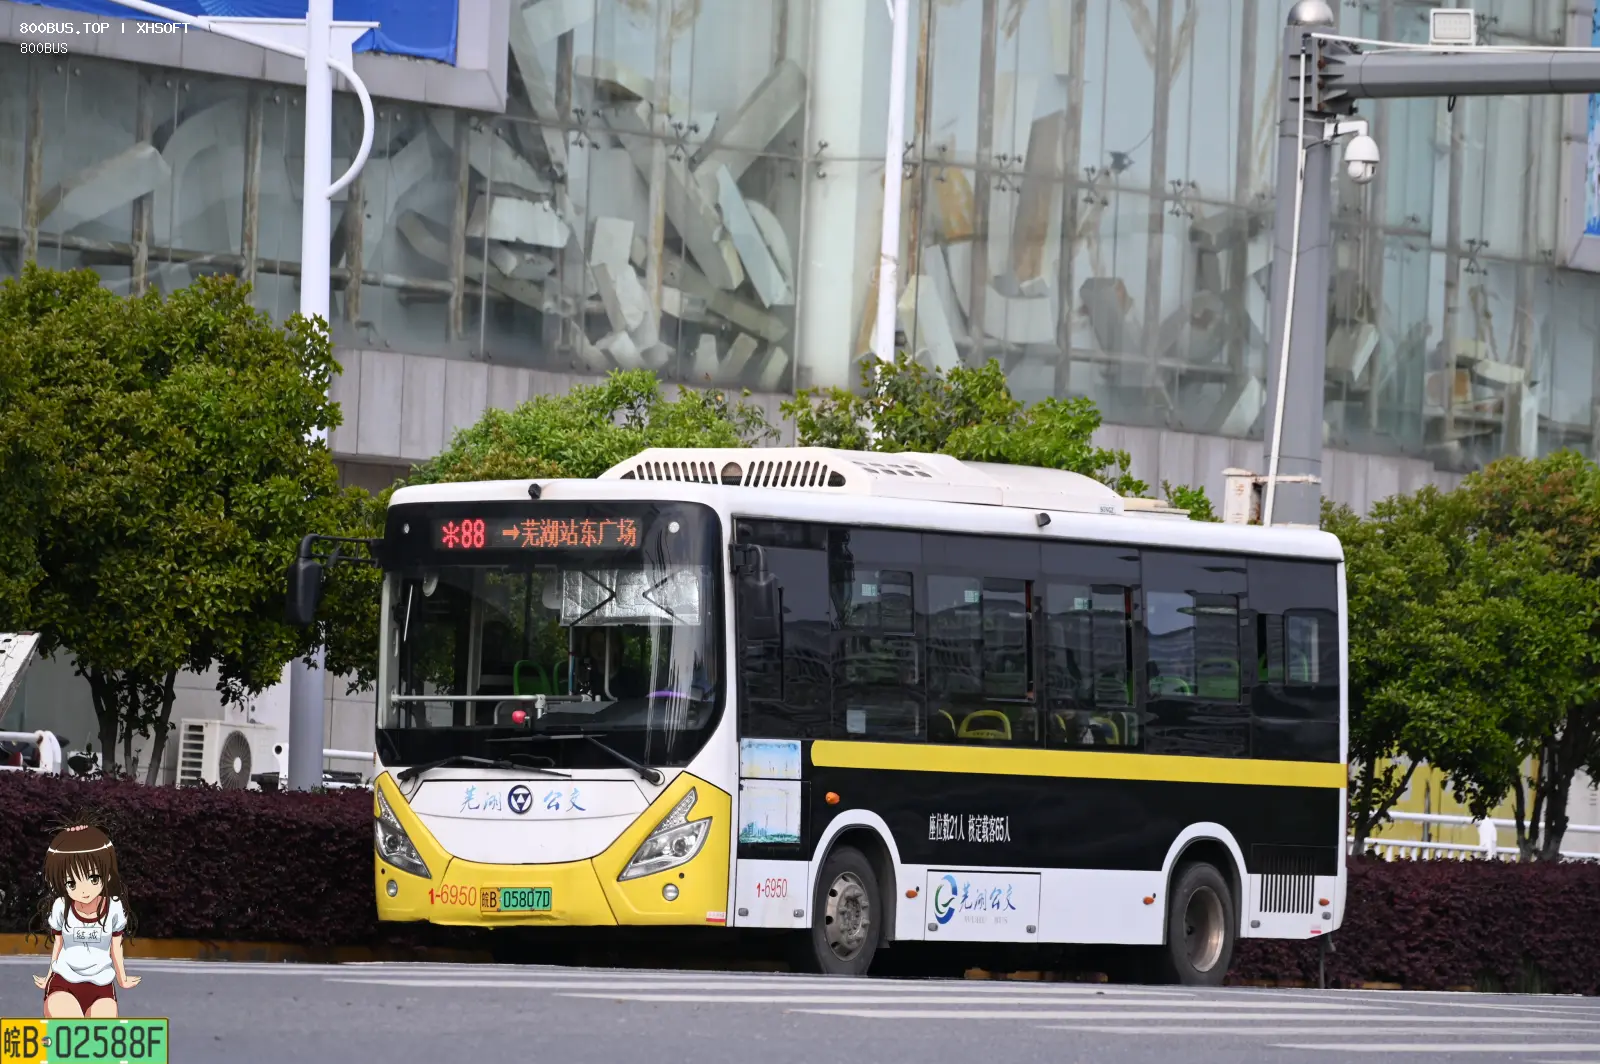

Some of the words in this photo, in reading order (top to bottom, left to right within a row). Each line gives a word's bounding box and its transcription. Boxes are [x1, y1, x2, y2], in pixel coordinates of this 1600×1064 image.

[520, 518, 637, 548] 芜湖站东广场
[460, 785, 502, 813] 芜湖
[543, 788, 587, 812] 公交
[928, 812, 965, 841] 座位数21人
[968, 814, 1011, 843] 核定载客65人
[428, 884, 477, 906] 1-6950
[756, 878, 788, 898] 1-6950
